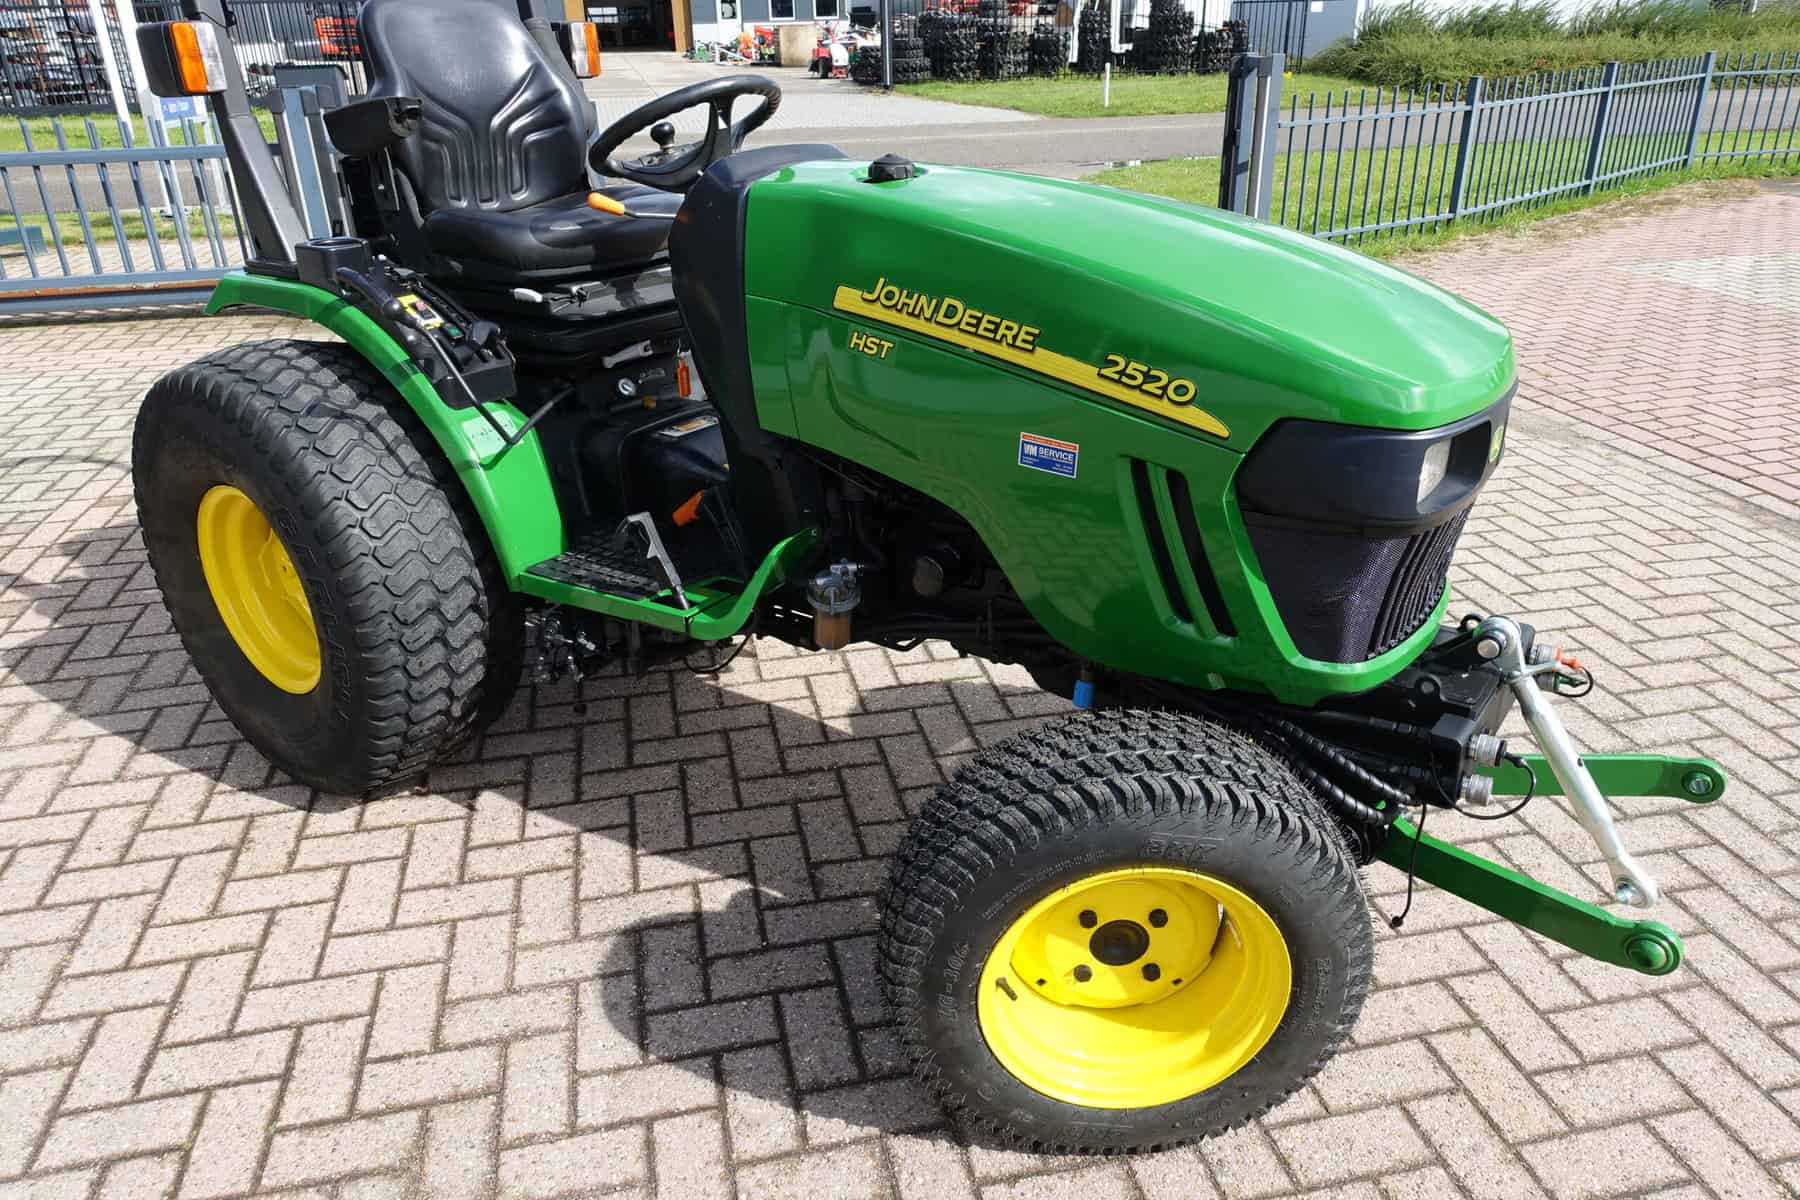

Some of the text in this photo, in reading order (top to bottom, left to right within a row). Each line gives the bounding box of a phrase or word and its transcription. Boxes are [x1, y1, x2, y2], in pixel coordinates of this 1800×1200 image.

[862, 277, 1041, 351] JOHN DEERE
[849, 331, 894, 359] HST
[1099, 353, 1197, 403] 2520
[1038, 446, 1073, 462] SERVICE
